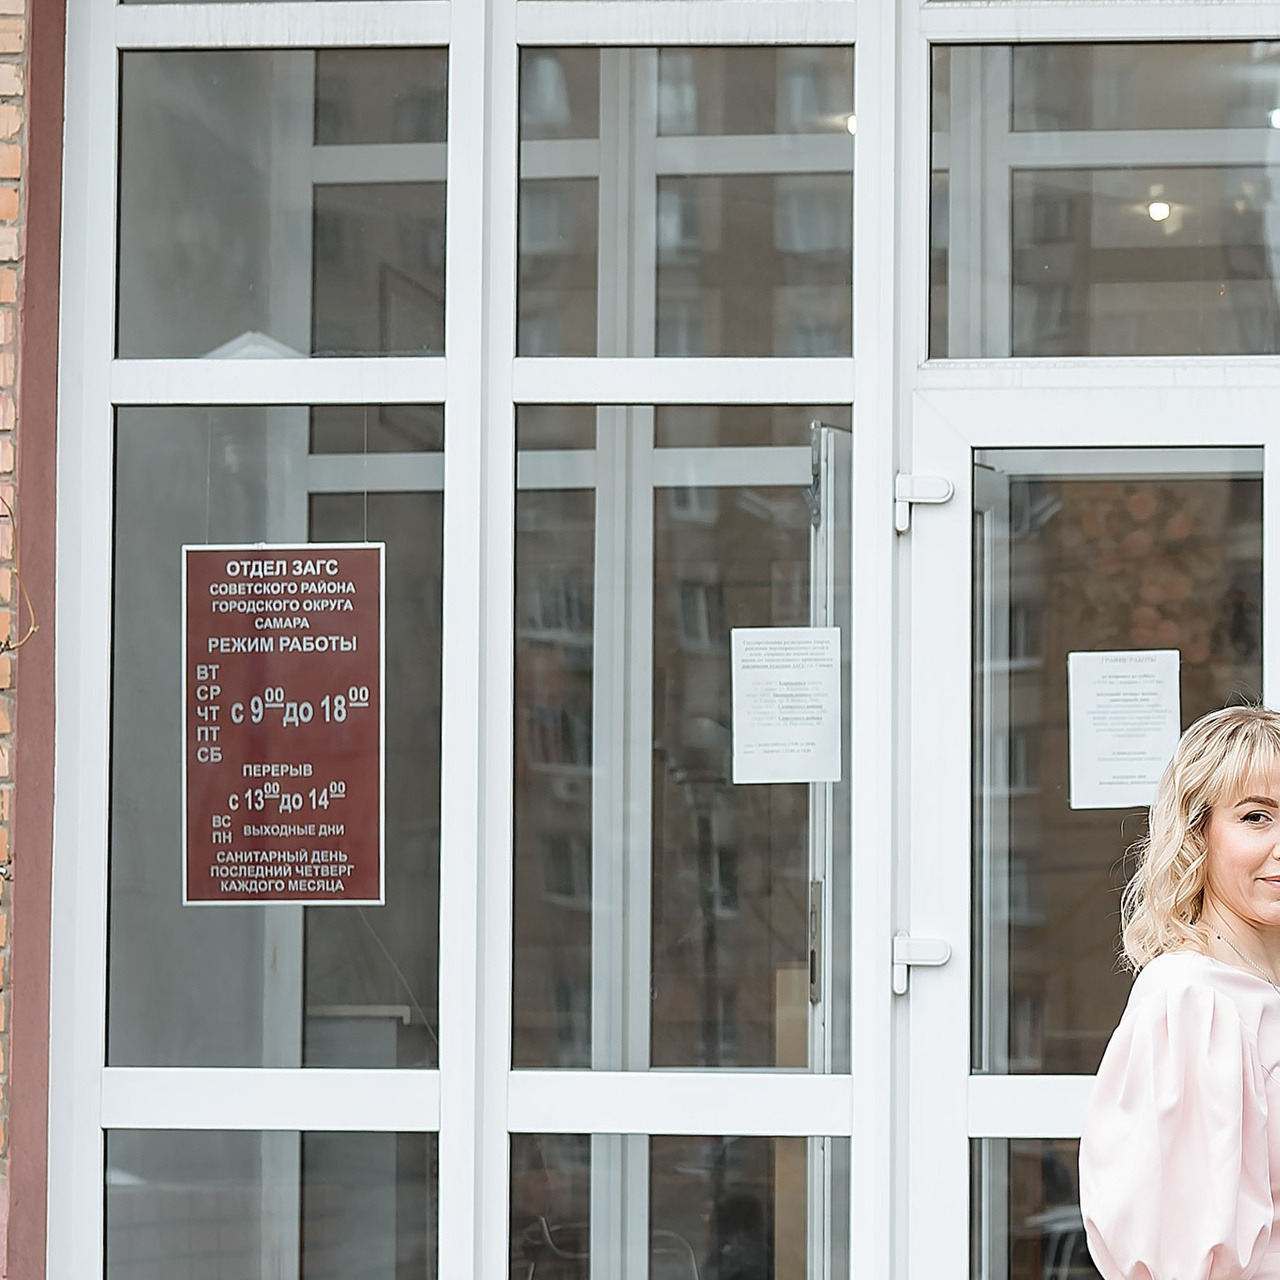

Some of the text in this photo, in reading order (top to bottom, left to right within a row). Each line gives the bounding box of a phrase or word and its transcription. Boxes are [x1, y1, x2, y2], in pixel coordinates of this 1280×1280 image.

[226, 559, 338, 578] ОТДЕЛ ЗАГС
[210, 580, 355, 596] СОВЕТСКОГО РАЙОНА
[212, 599, 353, 613] ГОРОДСКОГО ОКРУГА
[254, 617, 310, 630] САМАРА
[208, 636, 356, 653] РЕЖИМ РАБОТЫ
[197, 665, 220, 680] ВТ
[196, 685, 221, 700] СР
[197, 706, 220, 721] ЧТ
[283, 703, 313, 727] до
[197, 727, 220, 742] ПТ
[197, 747, 222, 762] СБ
[243, 764, 312, 777] ПЕРЕРЫВ
[279, 792, 303, 813] до
[212, 815, 232, 828] ВС
[212, 831, 232, 844] ПН
[243, 824, 344, 838] ВЫХОДНЫЕ ДНИ
[216, 848, 347, 865] САНИТАРНЫЙ ДЕНЬ
[210, 863, 354, 879] ПОСЛЕДНИЙ ЧЕТВЕРГ
[220, 879, 344, 893] КАЖДОГО МЕСЯЦА
